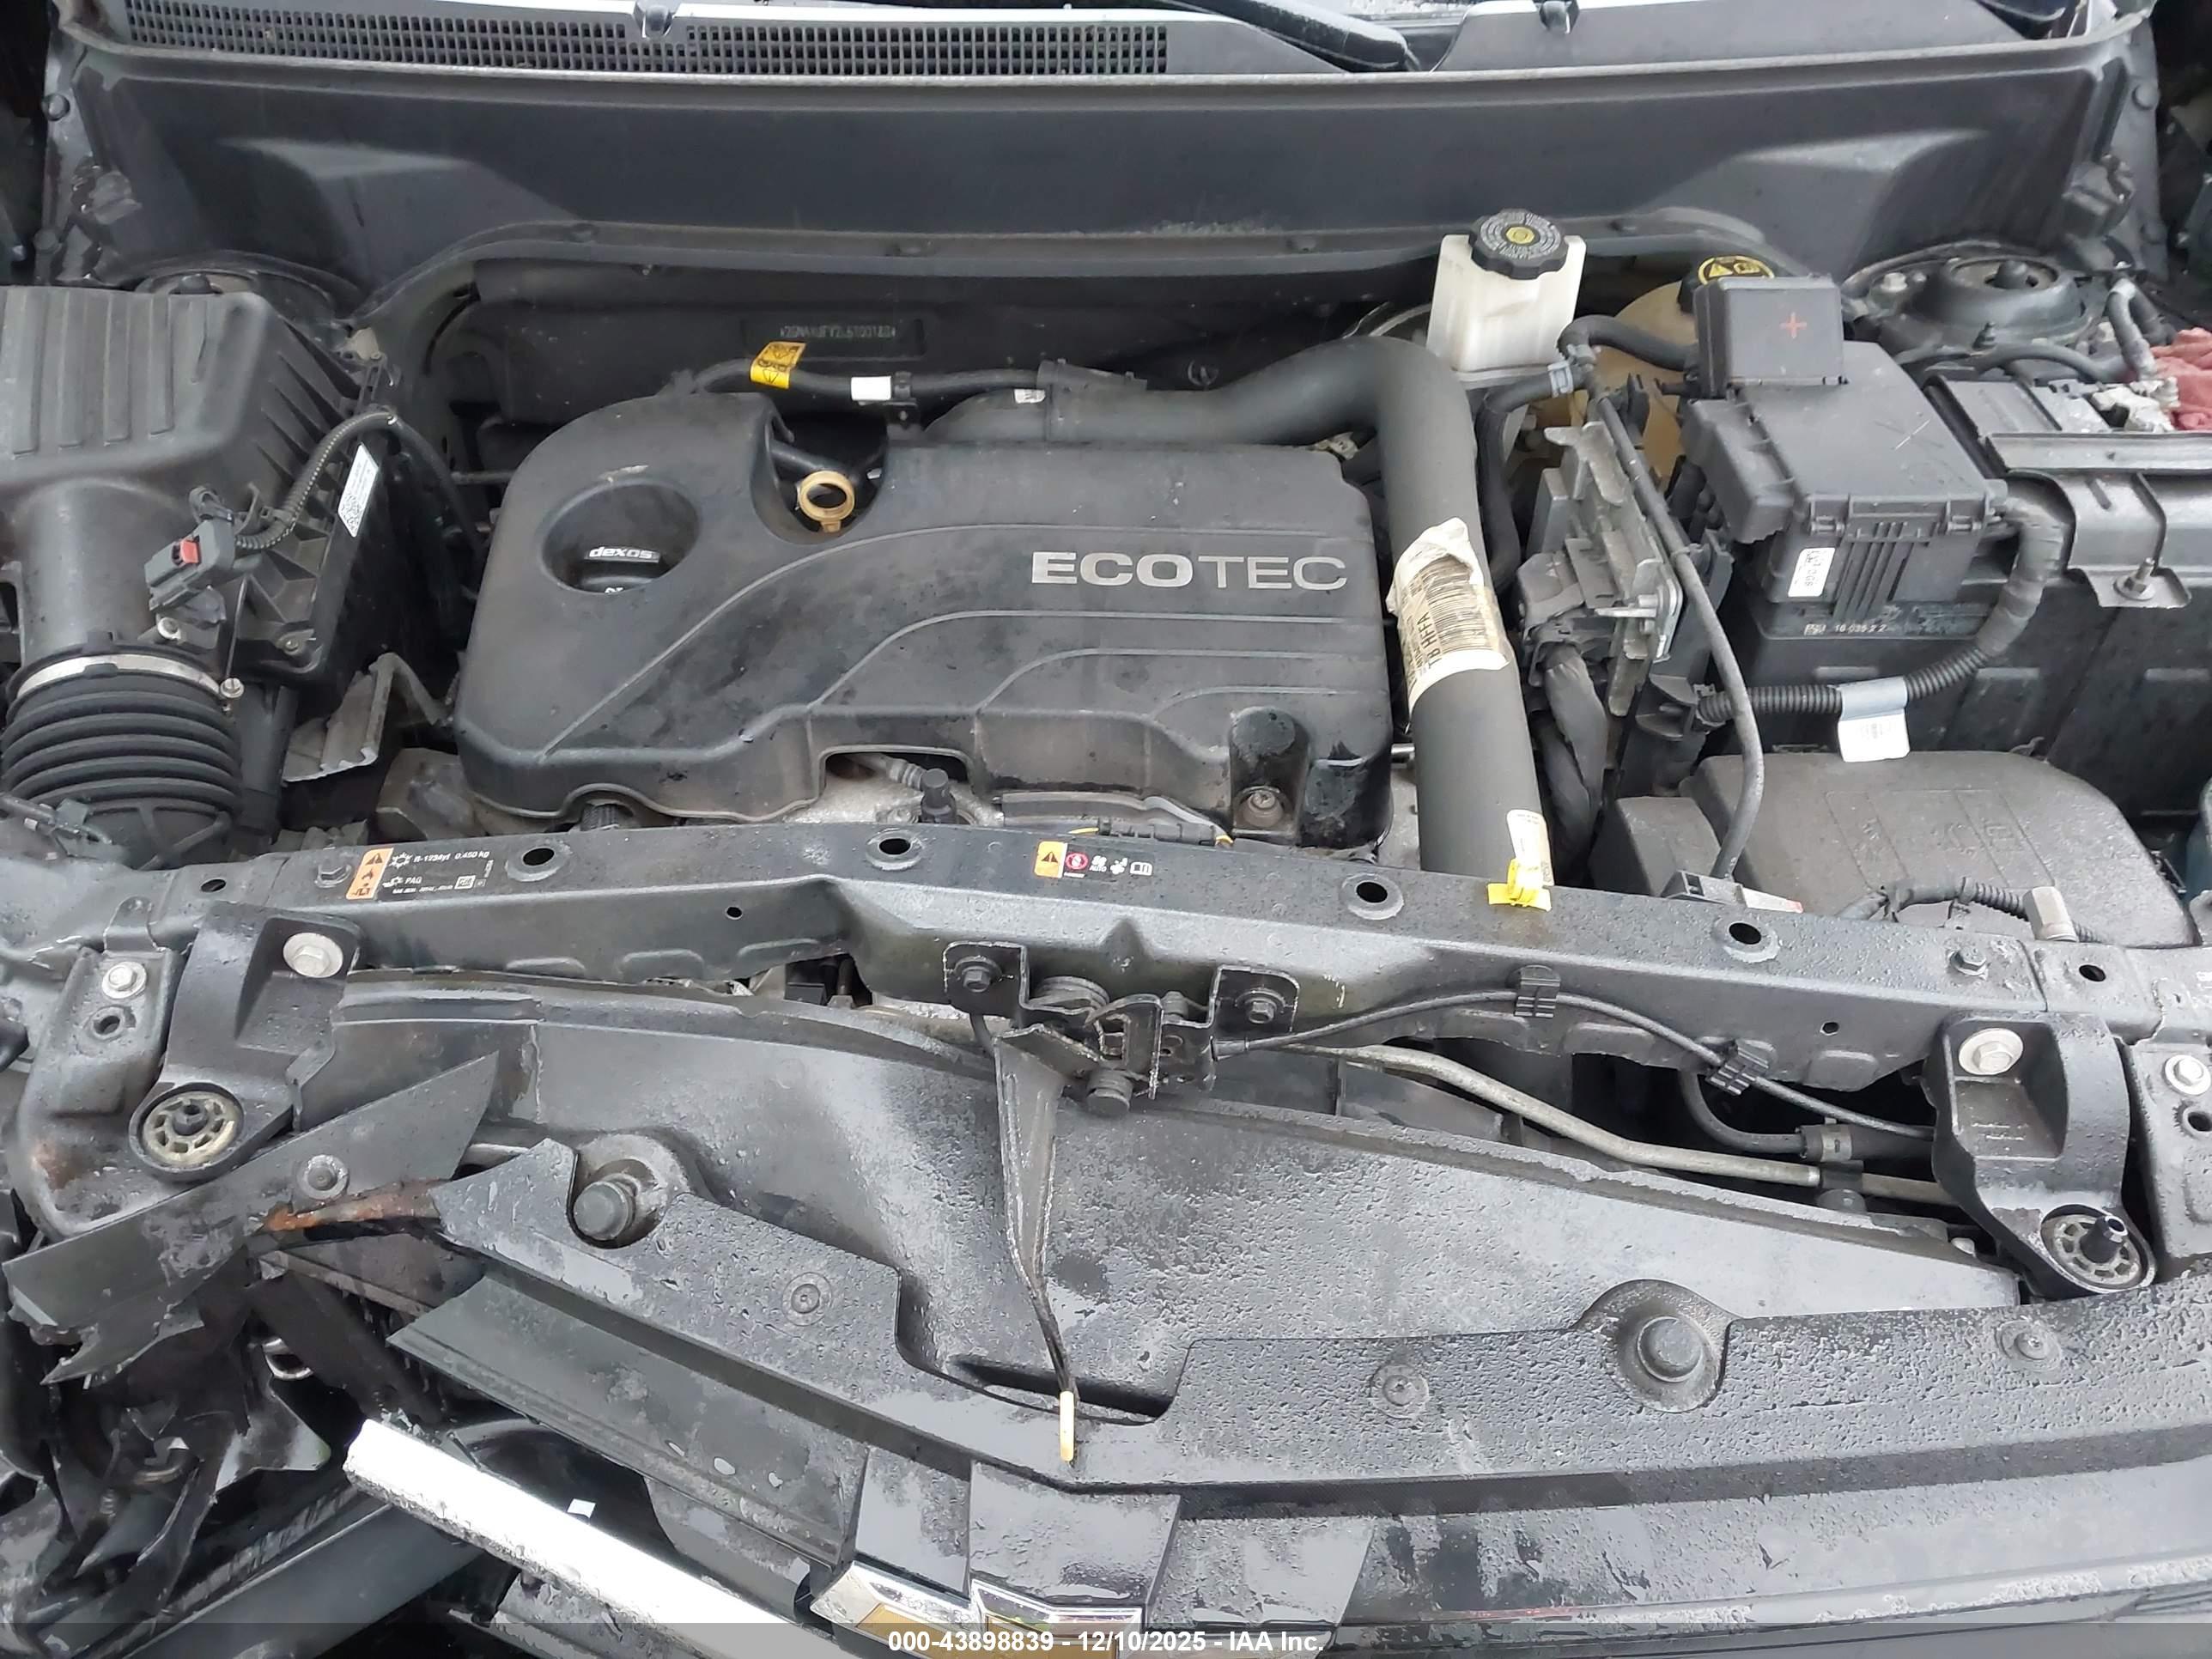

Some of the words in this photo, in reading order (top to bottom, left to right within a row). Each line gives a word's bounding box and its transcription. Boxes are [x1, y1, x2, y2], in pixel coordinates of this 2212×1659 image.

[588, 546, 653, 559] dexos
[1030, 551, 1347, 591] ECOTEC
[404, 876, 422, 884] PAG
